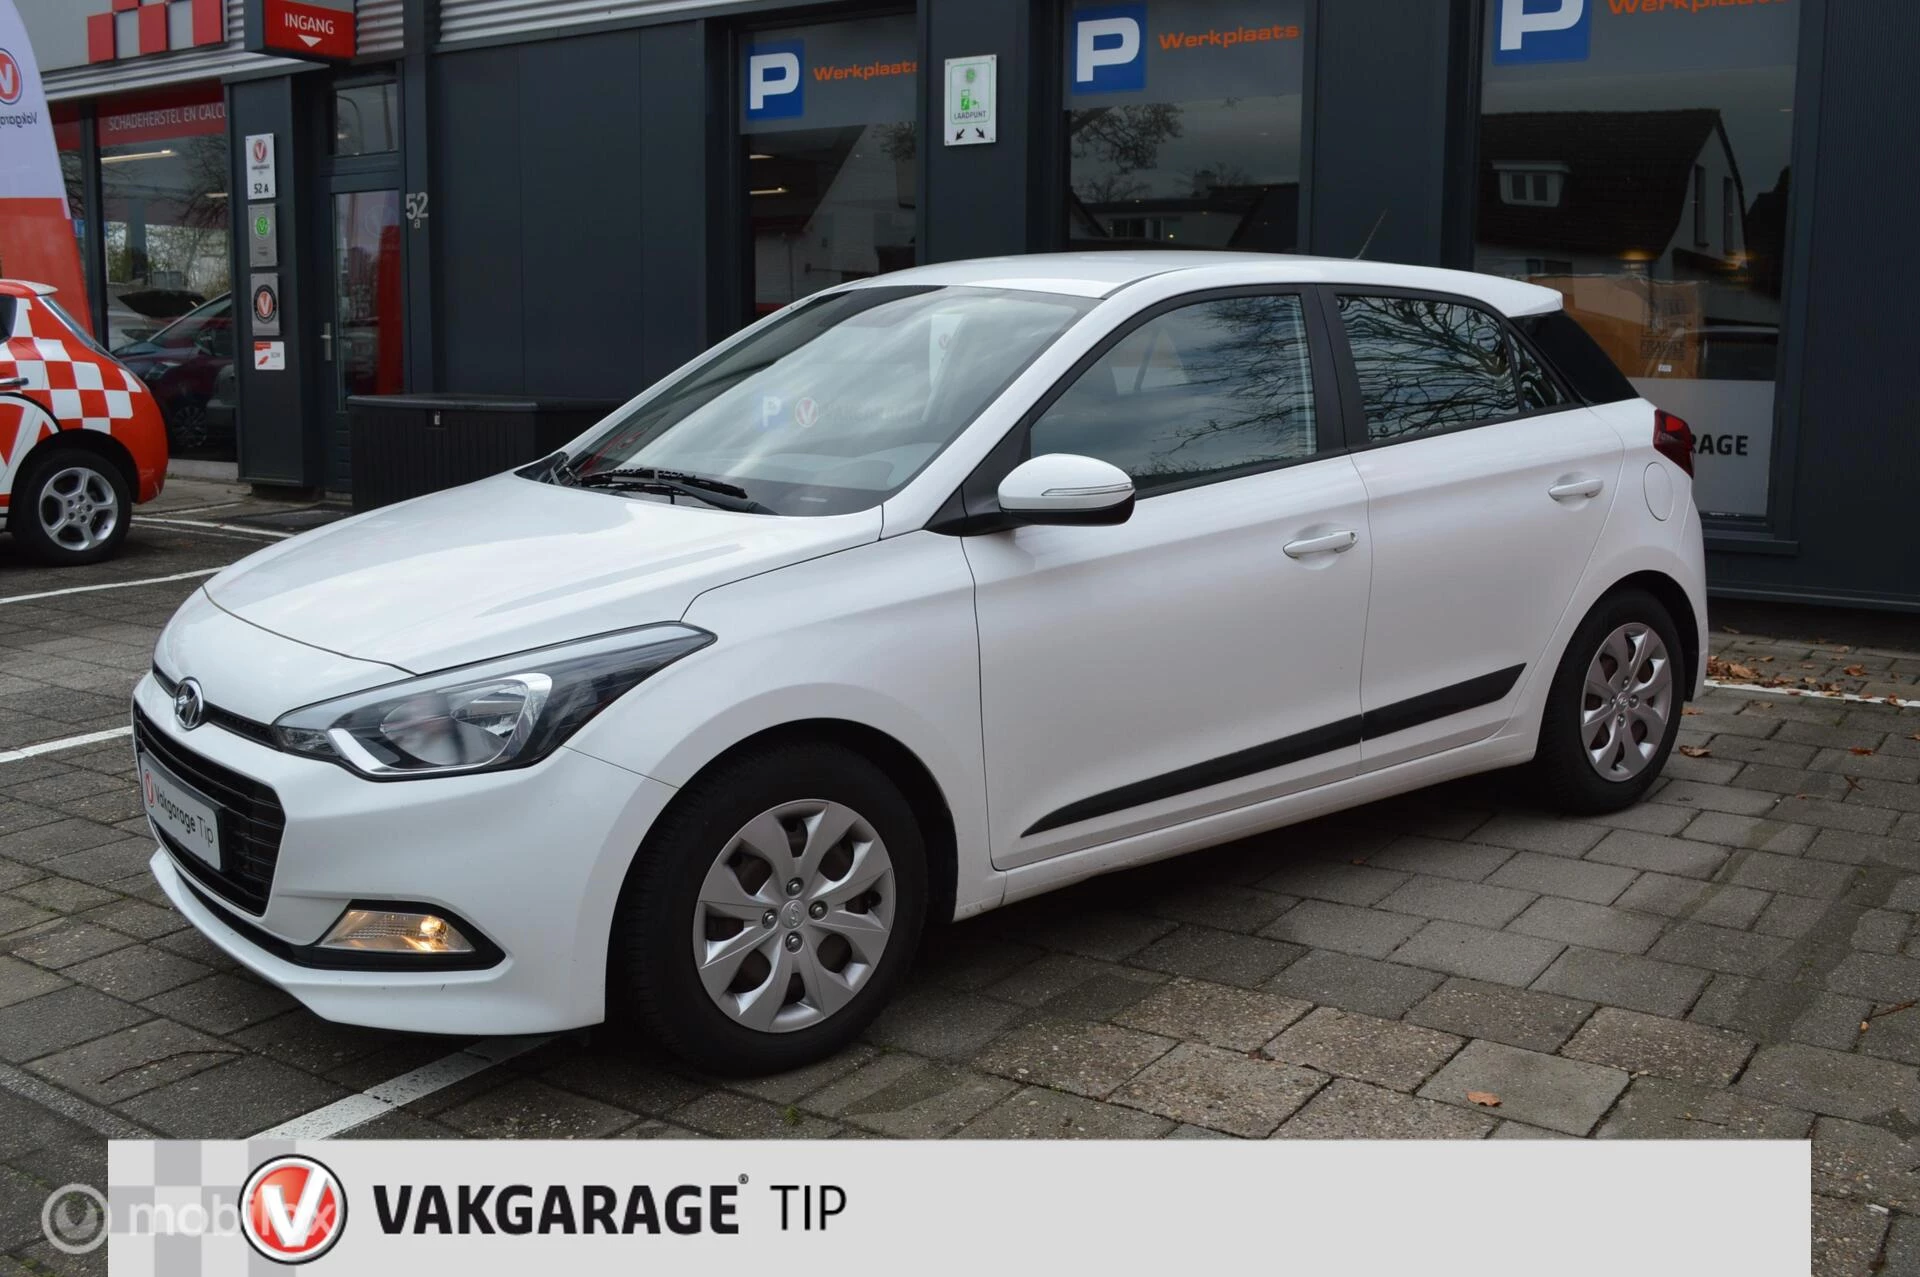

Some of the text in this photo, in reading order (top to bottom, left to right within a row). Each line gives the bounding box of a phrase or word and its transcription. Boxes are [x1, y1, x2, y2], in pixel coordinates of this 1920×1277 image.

[285, 12, 334, 35] INGANG
[1159, 24, 1300, 49] Werkplaats
[1077, 17, 1140, 82] P
[750, 52, 799, 109] P
[109, 108, 182, 131] SCHADEHERSTEL
[184, 106, 196, 122] EN
[953, 110, 987, 120] LAADPUNT
[254, 182, 270, 194] 52 A
[406, 192, 429, 220] 52
[414, 219, 421, 229] a
[155, 783, 214, 848] Vakgarage Tip
